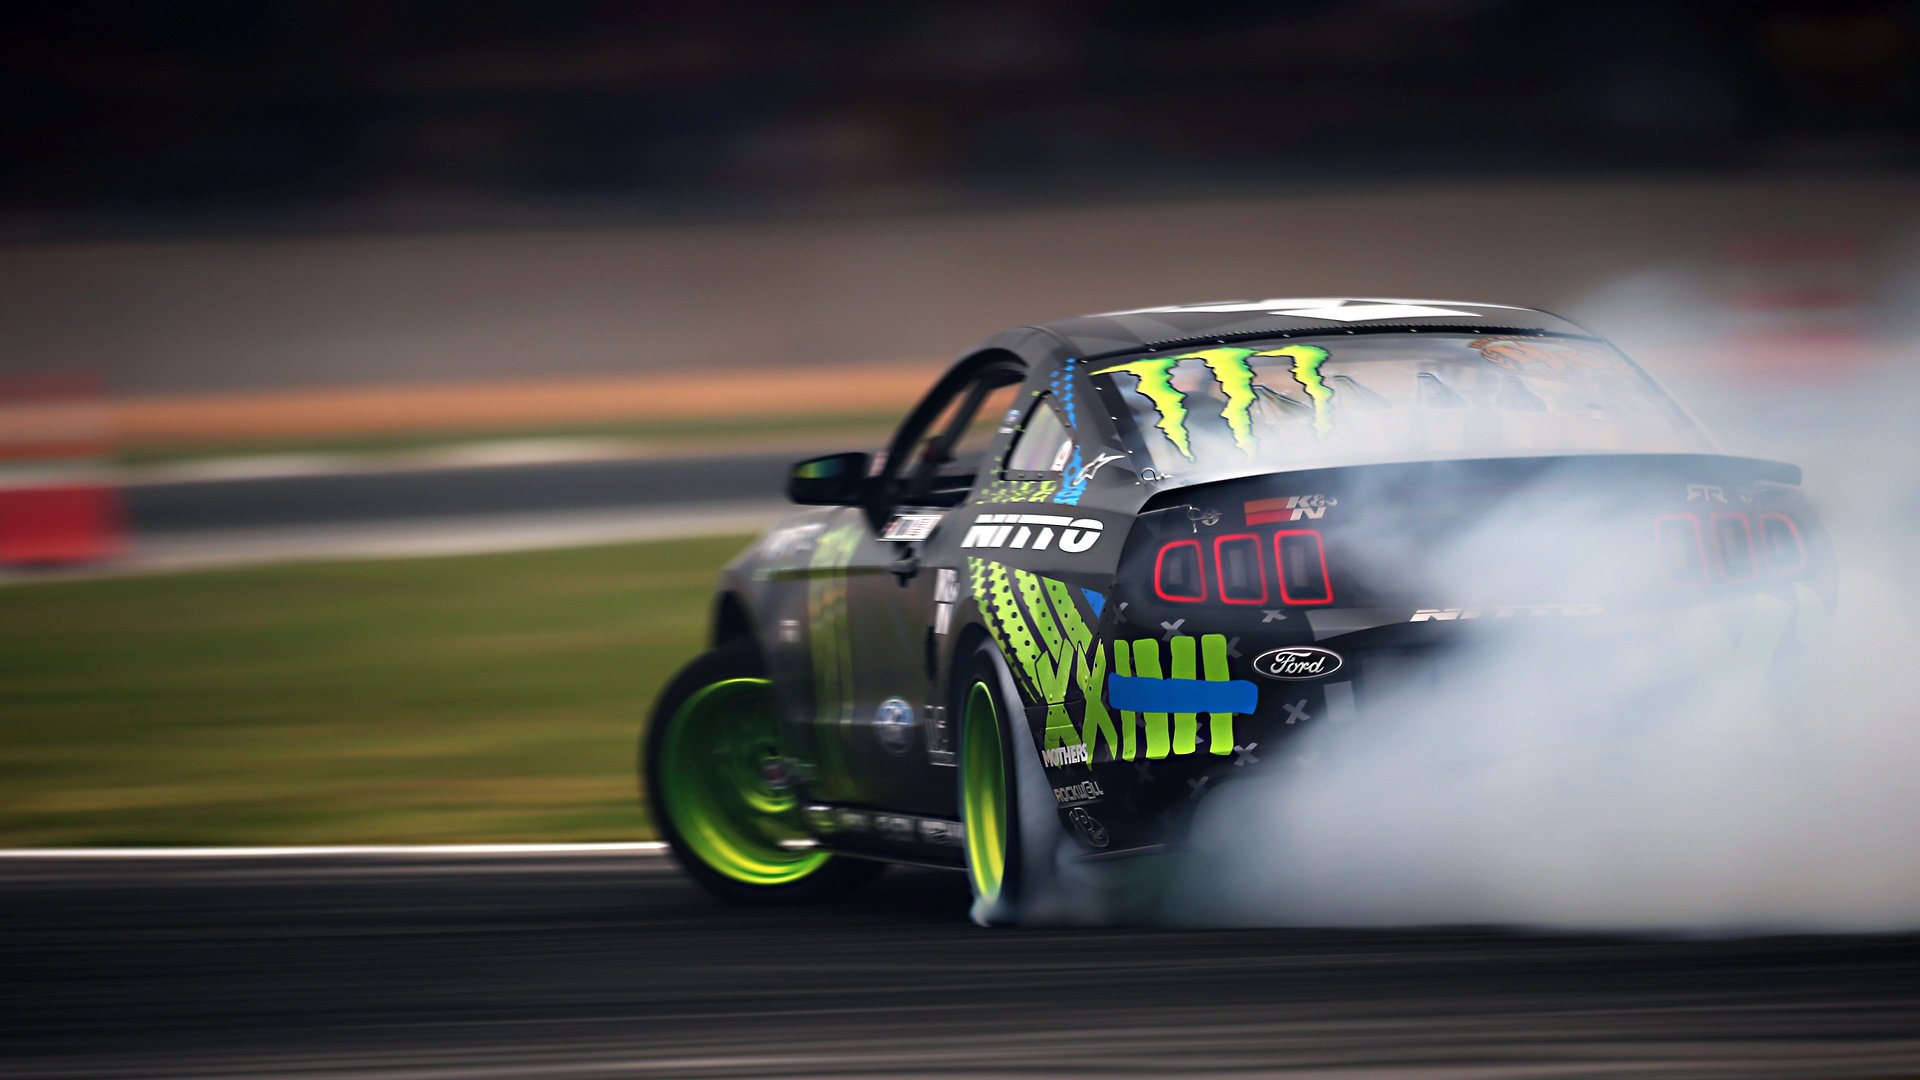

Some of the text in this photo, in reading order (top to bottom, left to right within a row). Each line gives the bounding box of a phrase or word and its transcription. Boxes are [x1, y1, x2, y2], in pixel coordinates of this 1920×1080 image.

[1286, 494, 1338, 521] K&N
[960, 514, 1104, 553] NITTO
[1270, 651, 1326, 674] Ford
[1042, 743, 1088, 768] MOTHERS
[1054, 781, 1104, 802] ROCKWELL
